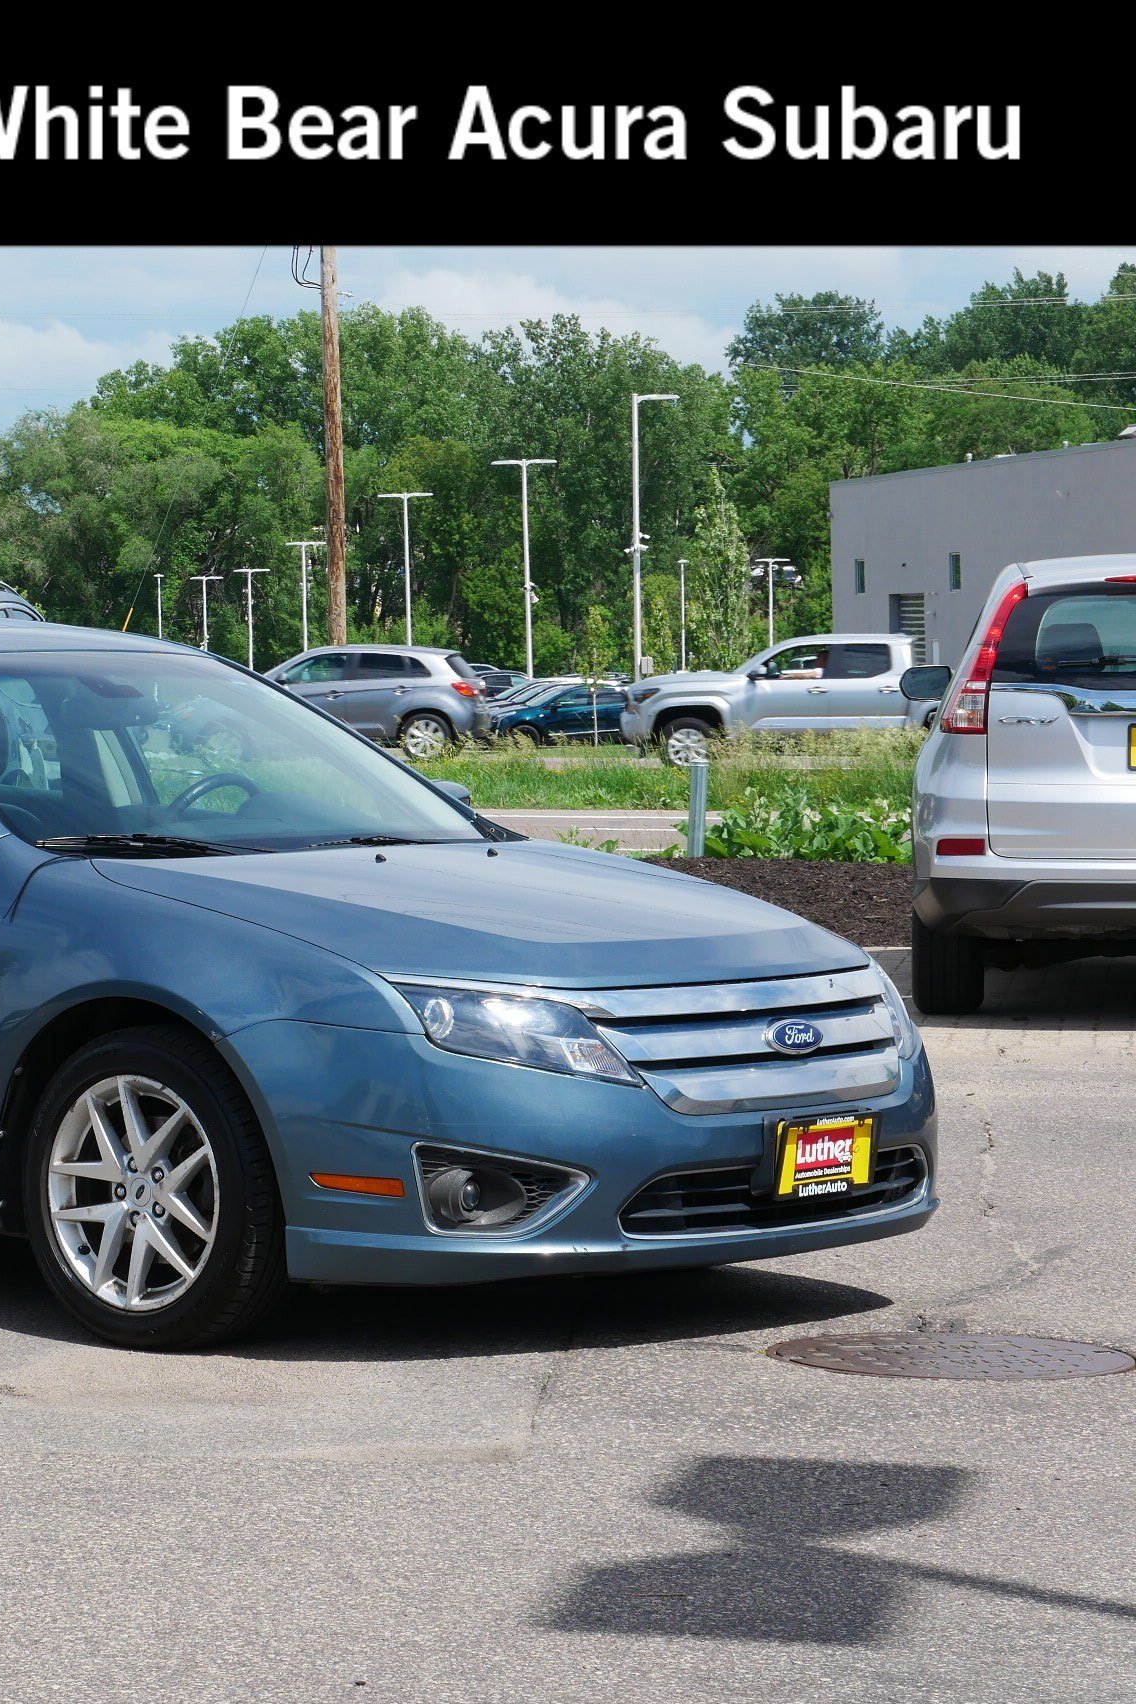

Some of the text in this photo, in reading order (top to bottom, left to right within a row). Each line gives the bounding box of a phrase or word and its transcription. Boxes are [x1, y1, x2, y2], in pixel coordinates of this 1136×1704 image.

[785, 1025, 815, 1044] Ford
[796, 1136, 853, 1164] Luther
[795, 1165, 851, 1179] Automobile Dealerships
[798, 1181, 847, 1197] LutherAuto
